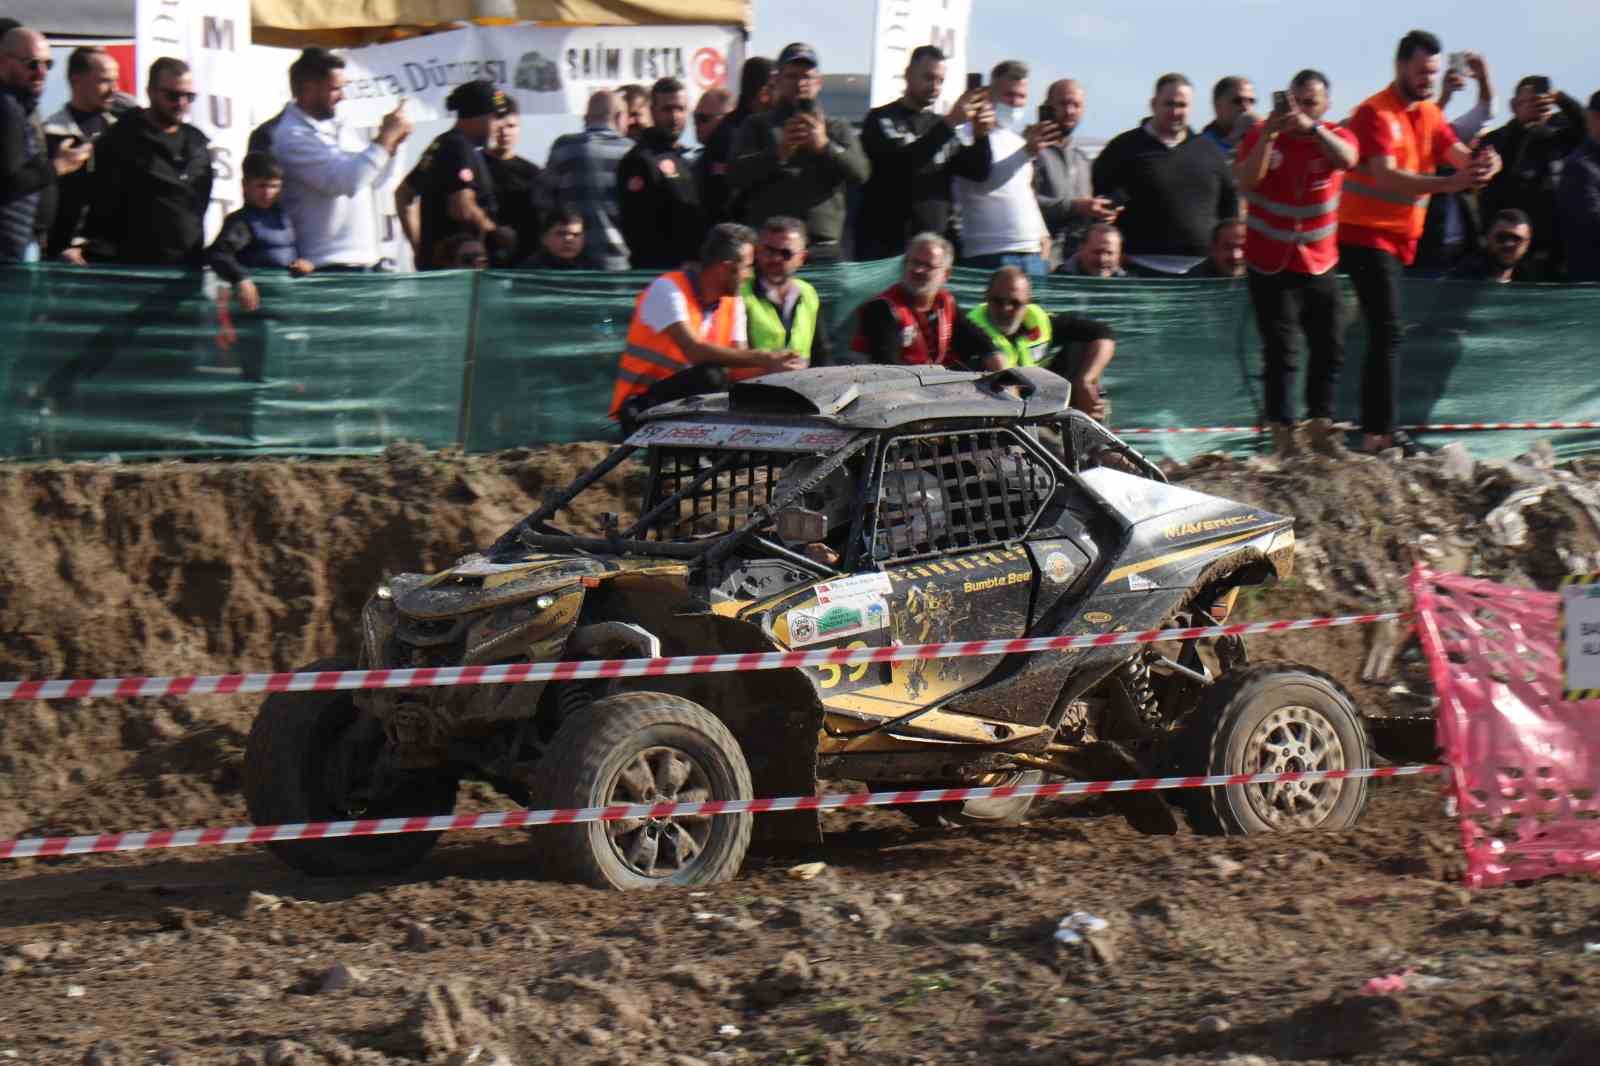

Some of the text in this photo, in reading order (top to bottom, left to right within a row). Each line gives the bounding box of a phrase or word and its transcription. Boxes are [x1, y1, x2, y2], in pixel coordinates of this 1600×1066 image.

[632, 47, 685, 79] USTA
[963, 572, 1033, 592] Bumble Bee
